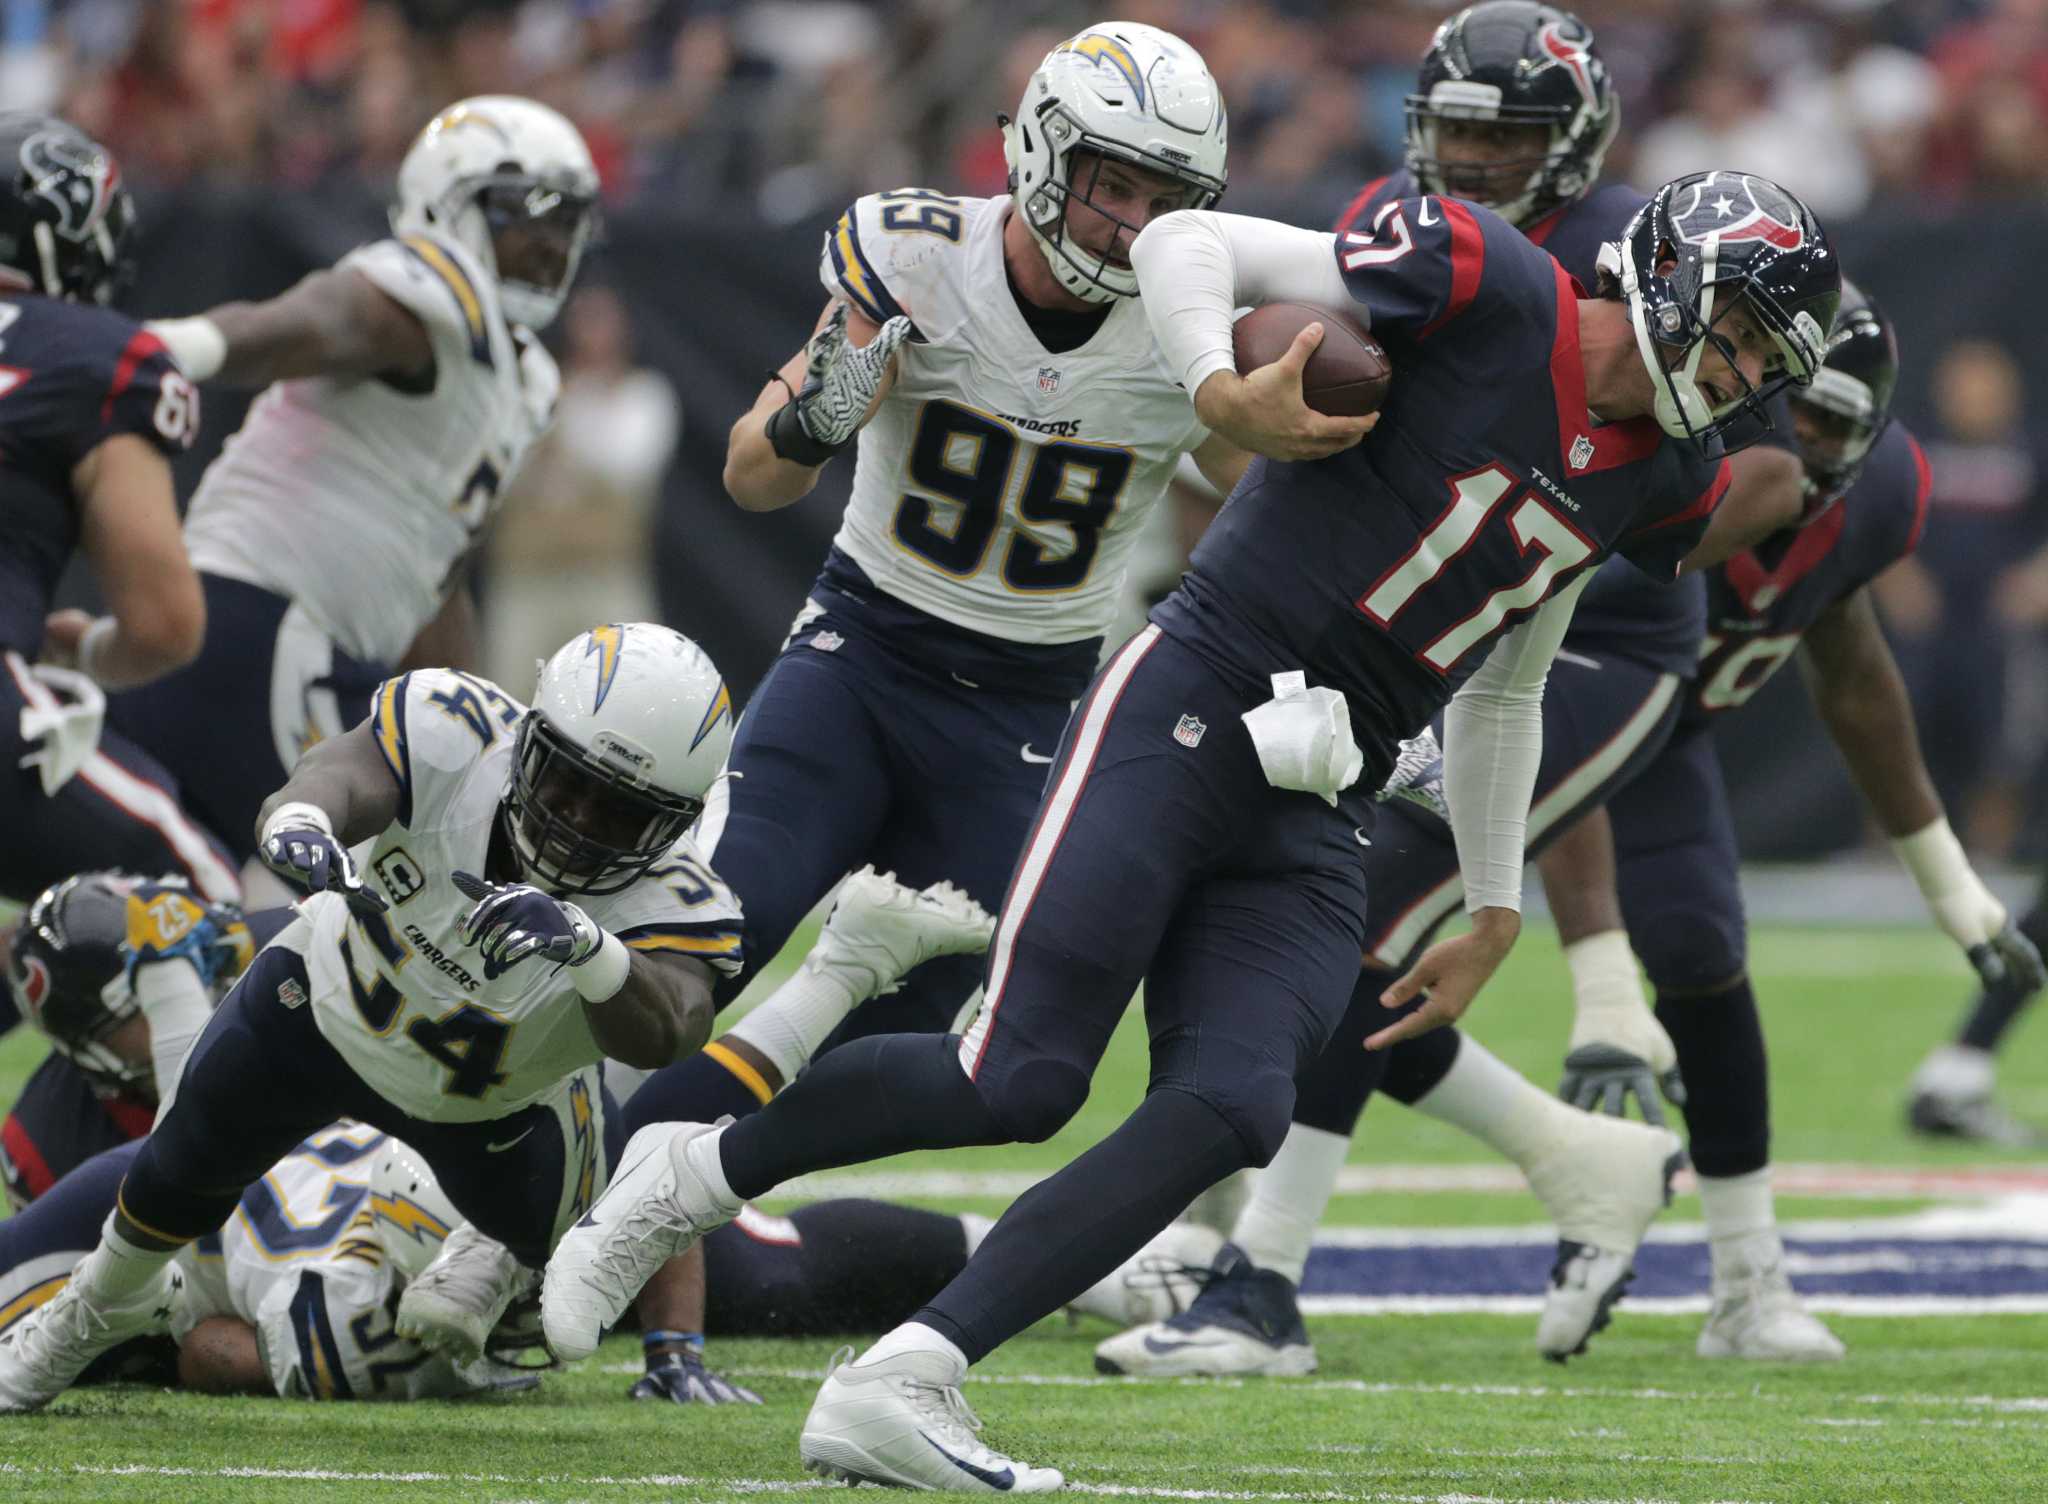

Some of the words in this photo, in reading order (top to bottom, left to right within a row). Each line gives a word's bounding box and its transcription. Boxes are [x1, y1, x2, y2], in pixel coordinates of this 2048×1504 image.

[889, 397, 1137, 596] 99
[1354, 459, 1600, 677] 17
[1531, 466, 1581, 512] TEXANS
[338, 905, 518, 1102] 54
[403, 924, 481, 993] CHARGERS
